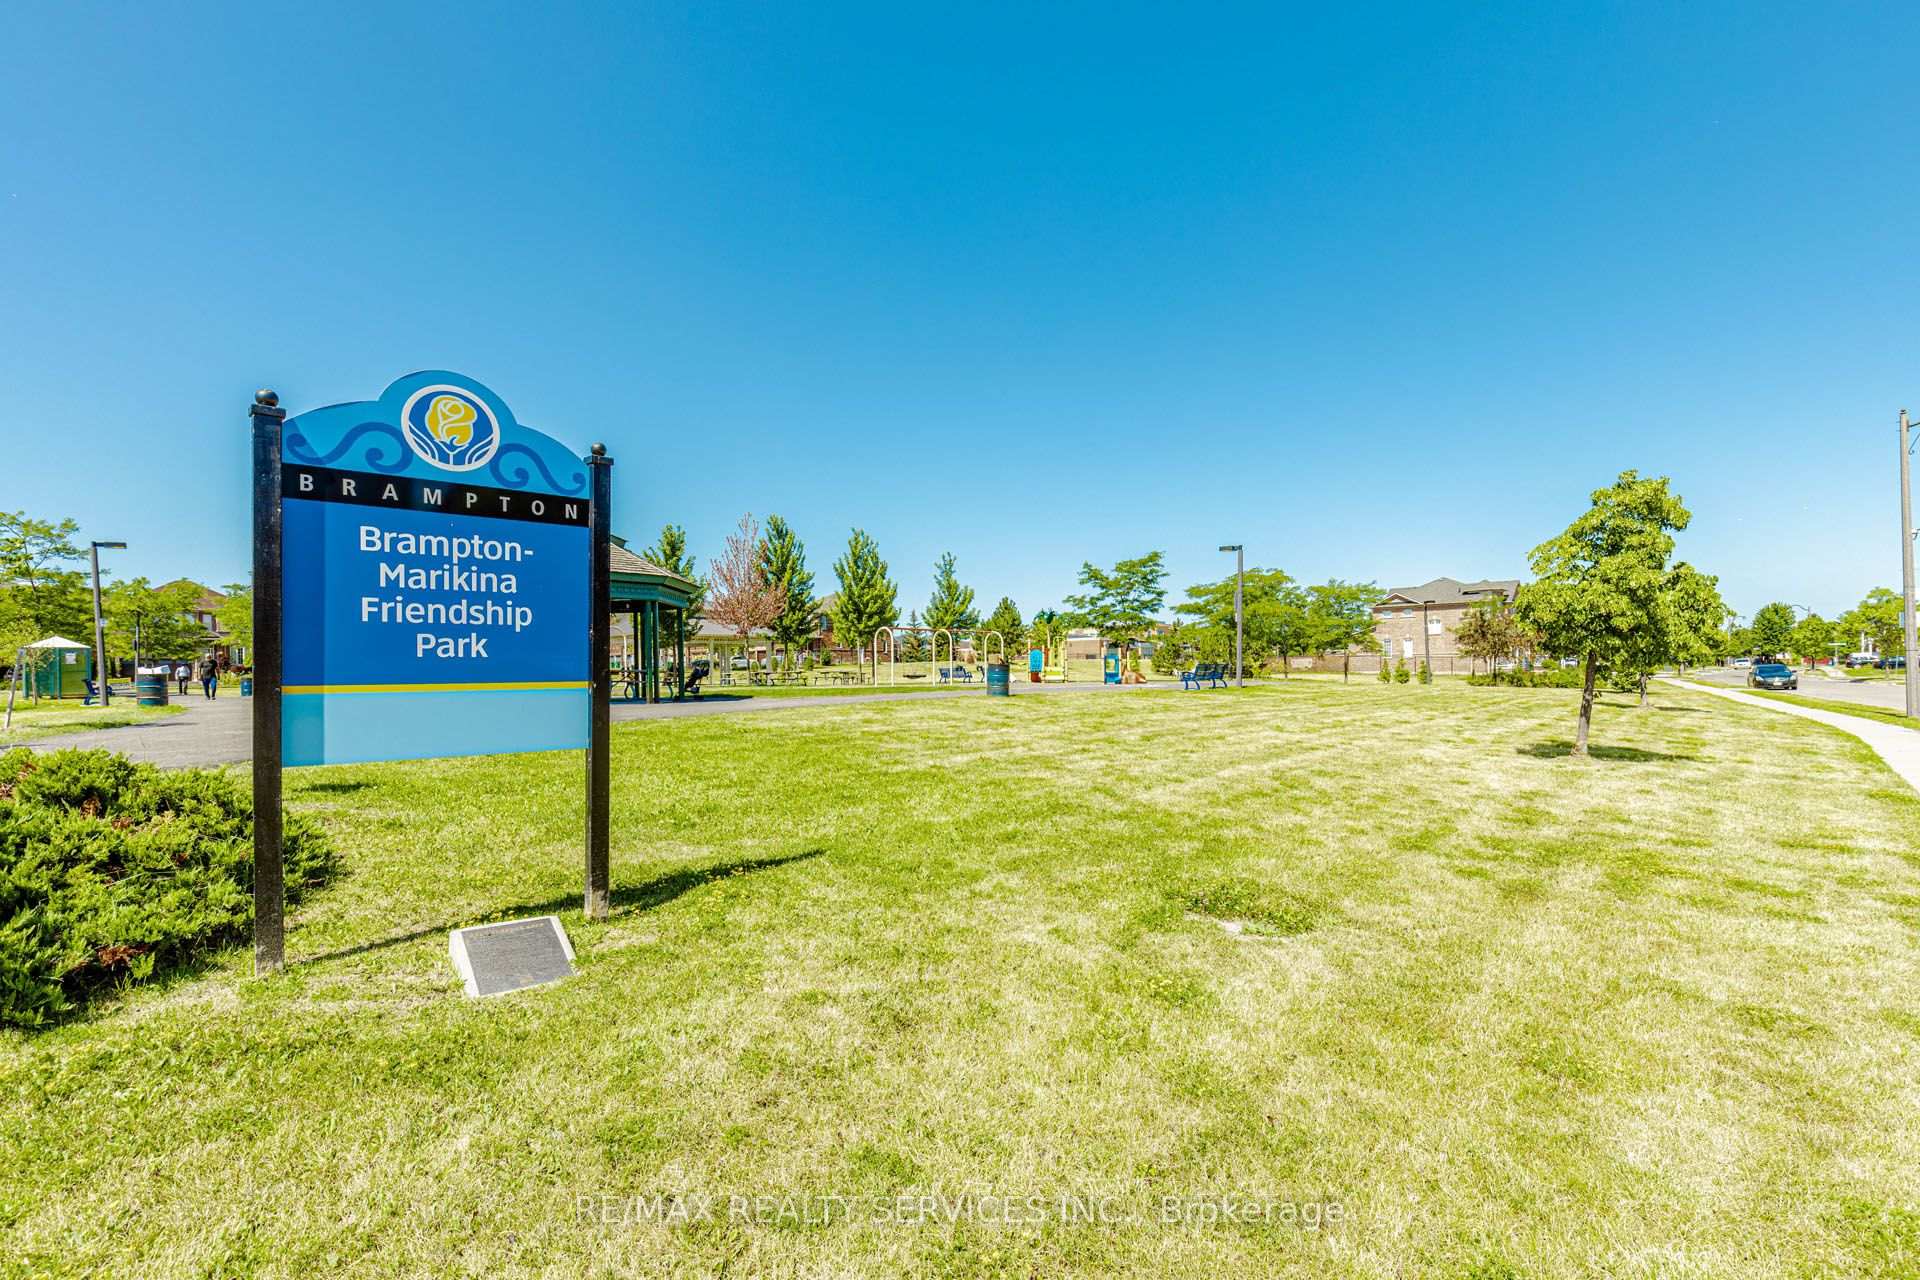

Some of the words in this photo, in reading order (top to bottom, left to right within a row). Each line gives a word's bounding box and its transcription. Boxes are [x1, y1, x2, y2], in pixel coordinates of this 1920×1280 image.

[299, 474, 578, 519] BRAMPTON
[359, 525, 534, 563] Brampton-
[379, 562, 517, 594] Marikina
[361, 595, 533, 632] Friendship
[416, 632, 489, 658] Park
